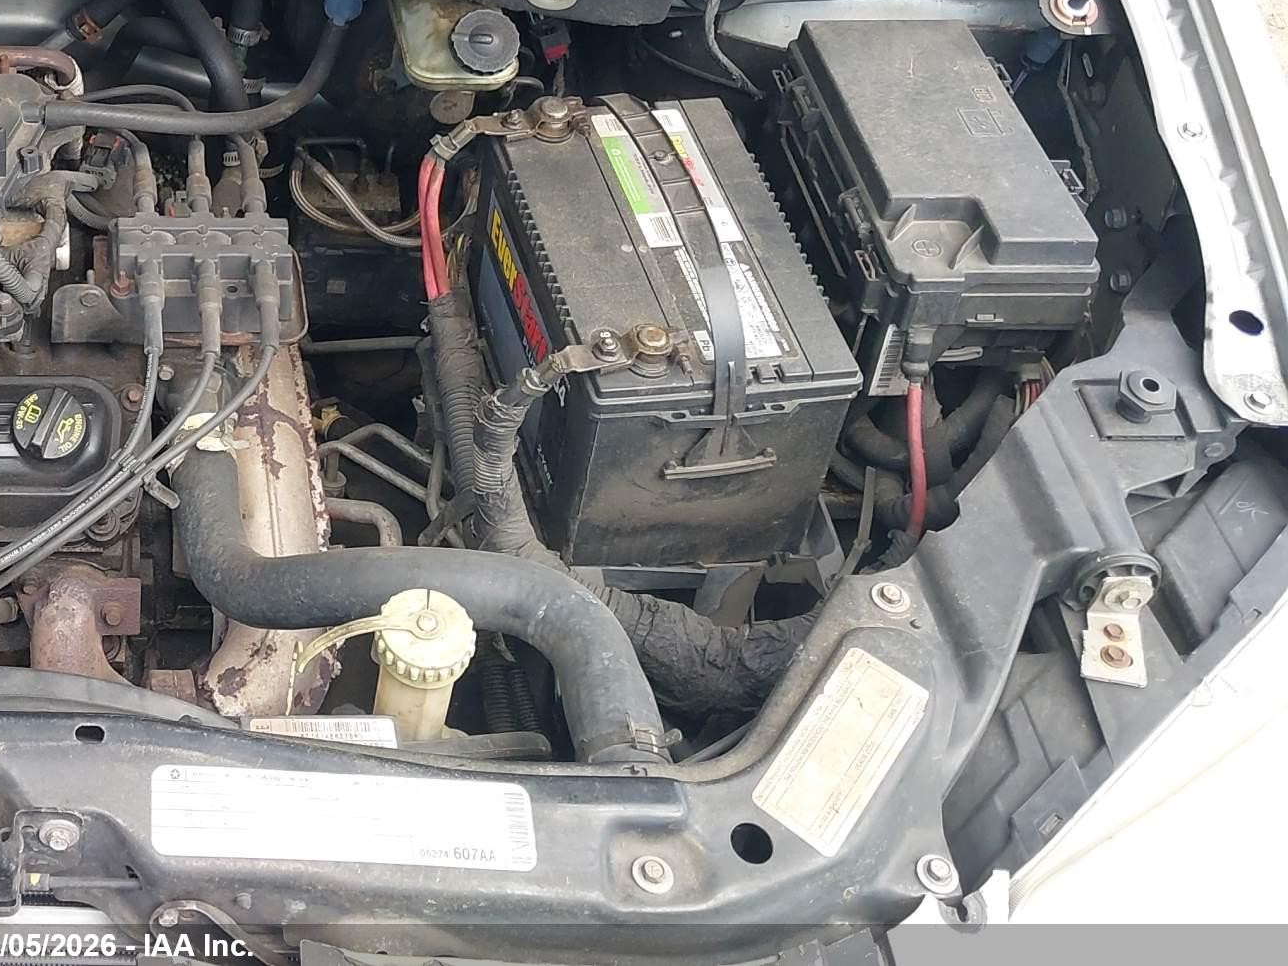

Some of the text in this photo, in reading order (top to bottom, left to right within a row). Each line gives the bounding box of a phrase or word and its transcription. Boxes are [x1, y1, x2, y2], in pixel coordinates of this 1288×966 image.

[699, 339, 711, 352] Pb
[15, 393, 39, 430] SAE 5W-20
[58, 413, 83, 453] ENGINE OIL
[453, 846, 497, 863] 607AA
